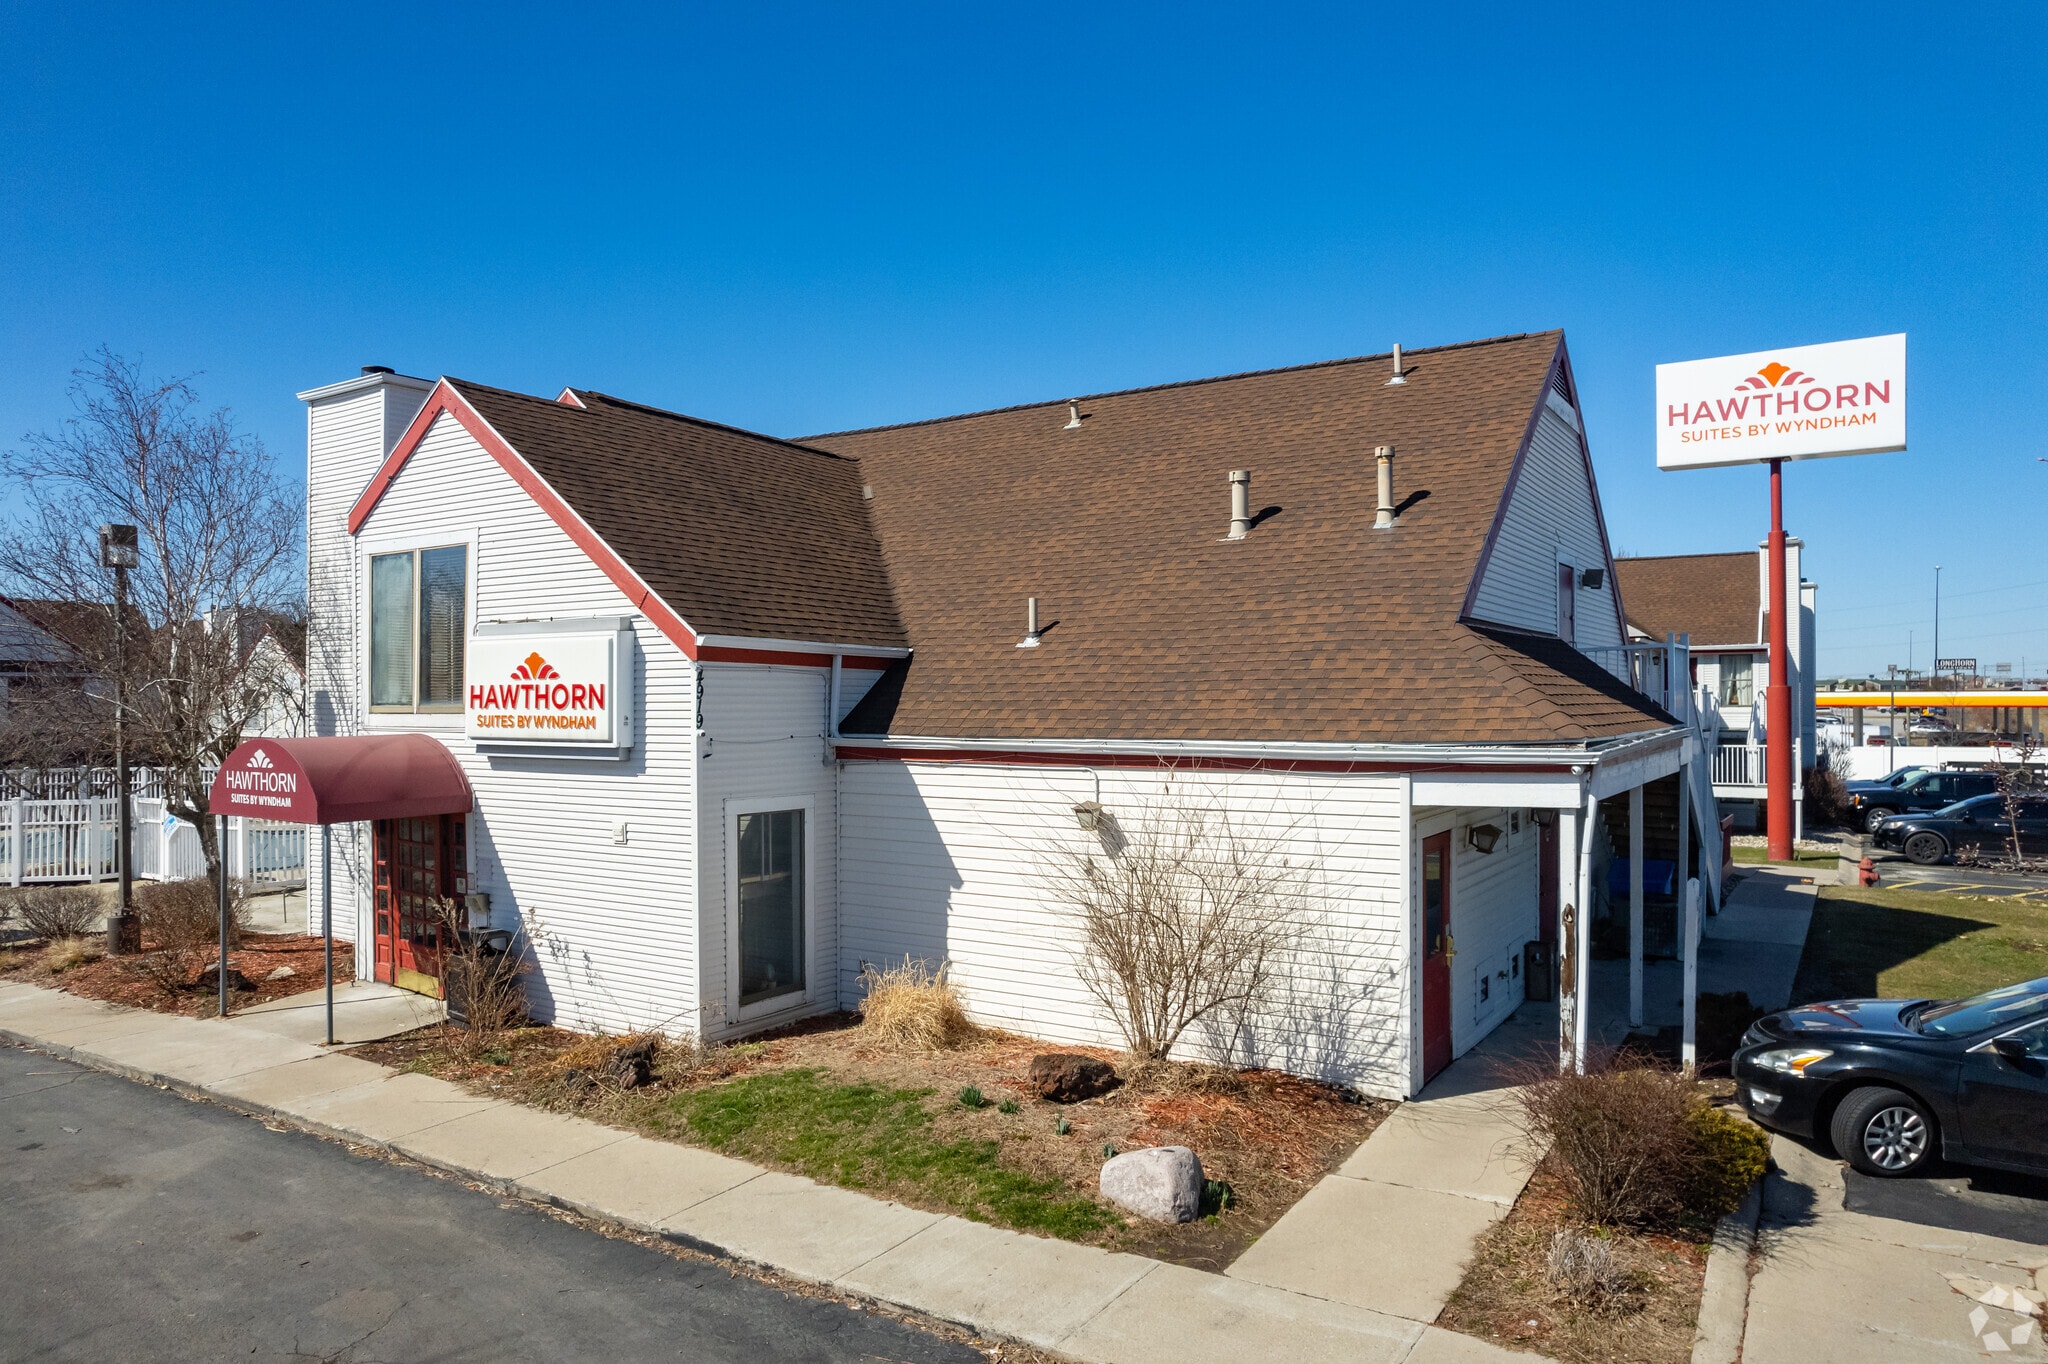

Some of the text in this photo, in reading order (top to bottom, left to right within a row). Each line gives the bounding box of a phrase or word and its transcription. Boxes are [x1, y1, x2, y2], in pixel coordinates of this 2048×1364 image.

[1668, 379, 1890, 427] HAWTHORN
[1681, 412, 1877, 443] SUITES BY WYNDHAM
[1936, 659, 1975, 667] LONGHORN
[470, 683, 605, 710] HAWTHORN
[477, 714, 596, 729] SUITES BY WYNDHAM
[226, 770, 296, 793] HAWTHORN
[231, 793, 292, 807] SUITES BY WYNDHAM
